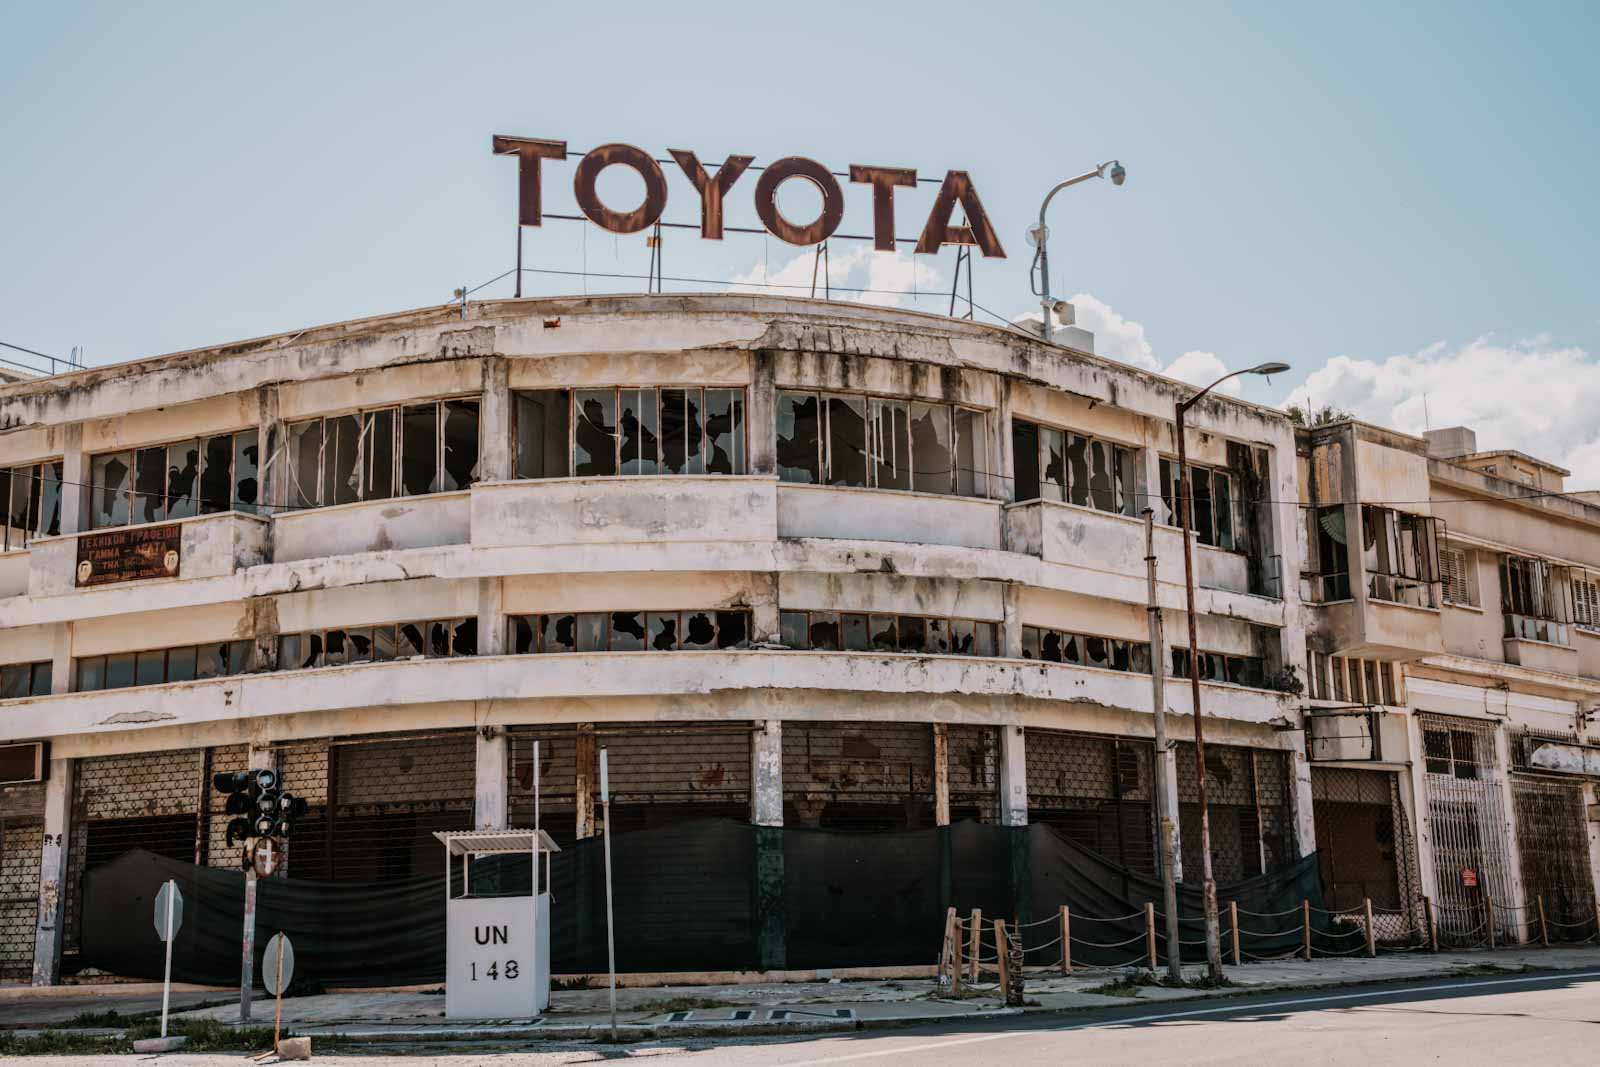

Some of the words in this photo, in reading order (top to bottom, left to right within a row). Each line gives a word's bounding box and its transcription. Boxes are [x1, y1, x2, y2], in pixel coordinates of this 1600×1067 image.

[493, 134, 1007, 258] TOYOTA
[475, 925, 508, 945] UN
[471, 960, 519, 980] 148
